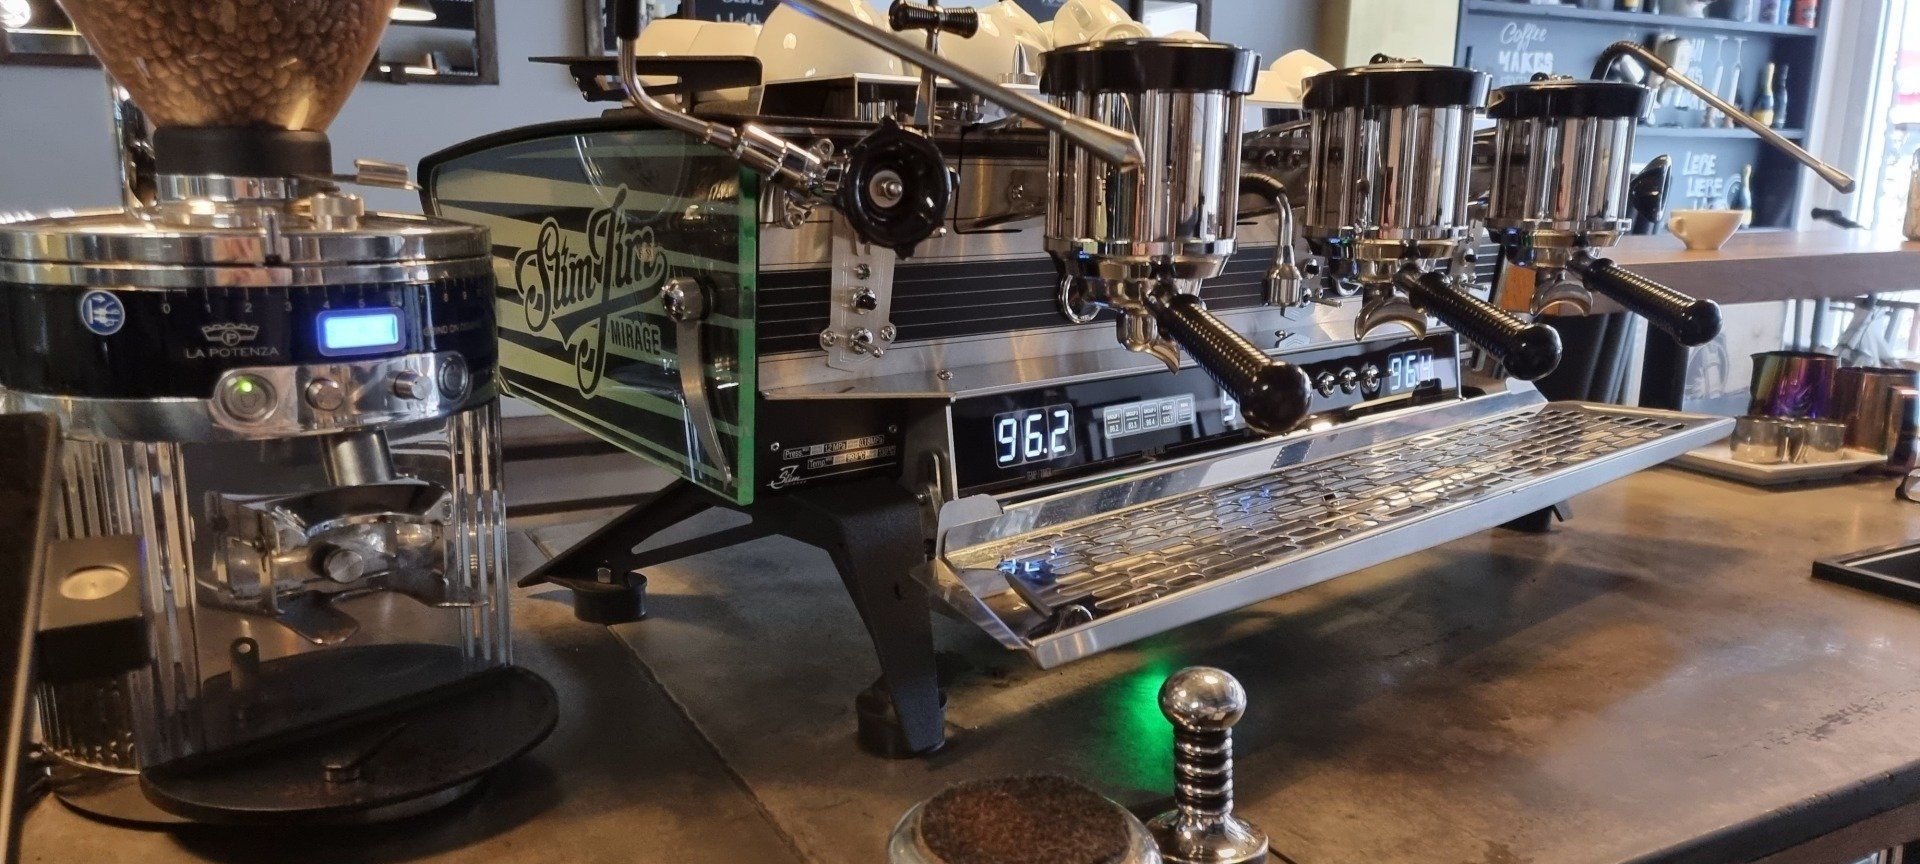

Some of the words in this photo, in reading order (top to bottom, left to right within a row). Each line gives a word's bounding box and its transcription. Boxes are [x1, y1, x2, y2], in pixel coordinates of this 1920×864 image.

[1500, 22, 1547, 51] Coffee
[163, 303, 171, 314] 0
[245, 302, 252, 313] 2
[285, 301, 292, 312] 3
[611, 319, 661, 355] MIRAGE
[186, 348, 206, 359] LA
[209, 346, 280, 358] POTENZA
[998, 410, 1069, 462] 96.2
